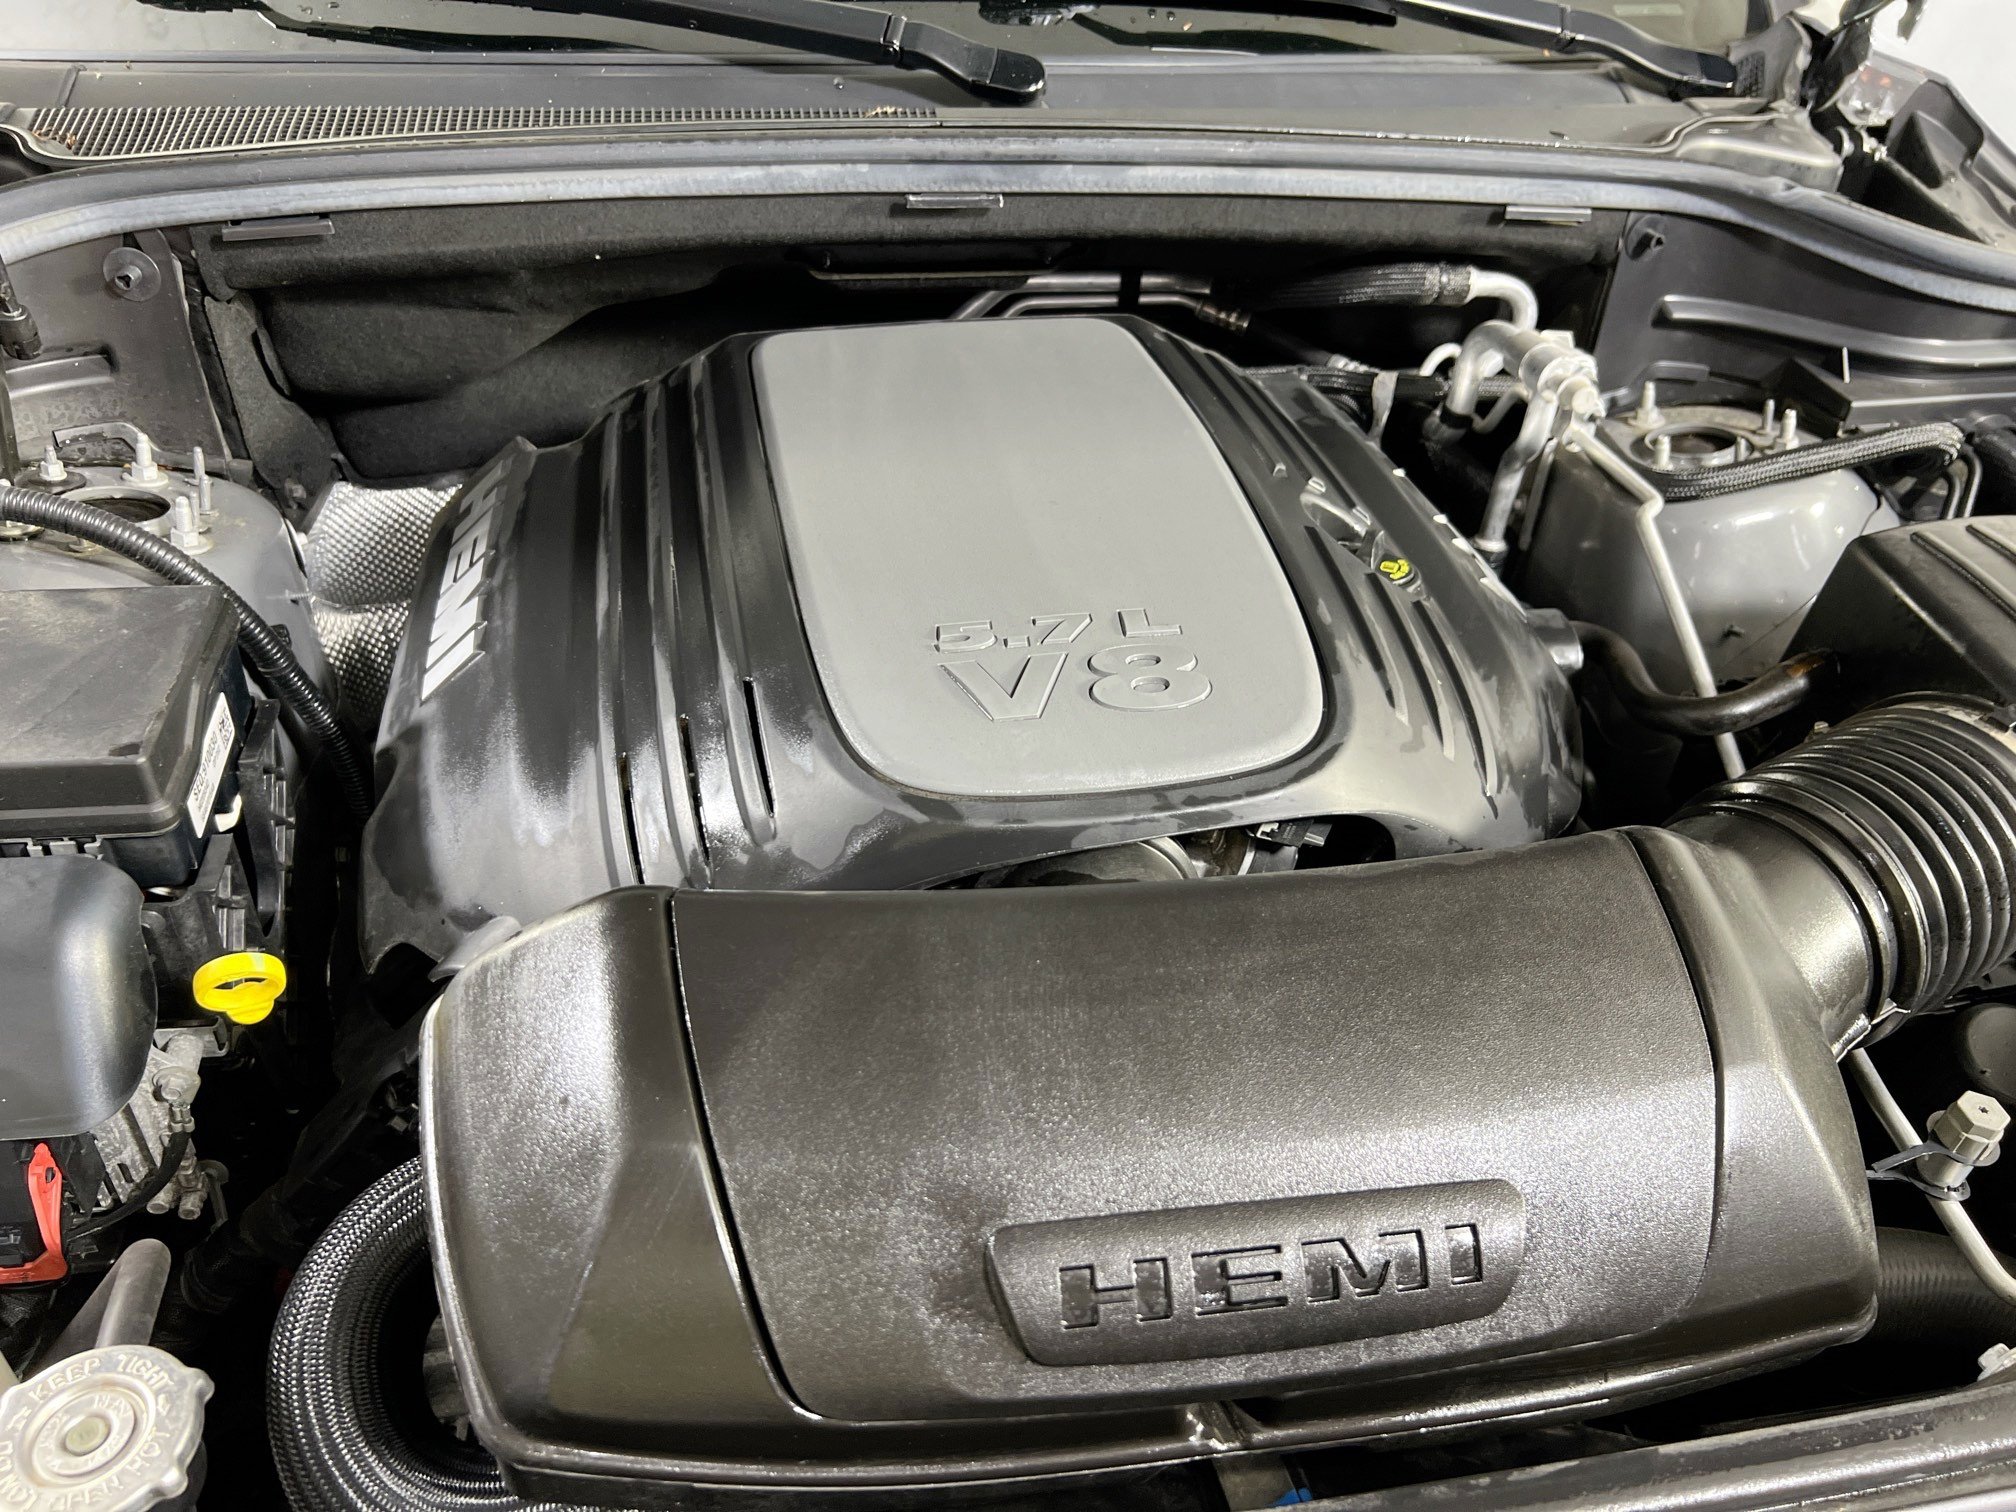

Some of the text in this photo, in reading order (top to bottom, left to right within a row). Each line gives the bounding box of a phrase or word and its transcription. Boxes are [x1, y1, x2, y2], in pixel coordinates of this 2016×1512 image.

[420, 456, 506, 701] HEMI
[936, 642, 1213, 722] V8
[1058, 1222, 1484, 1330] HEMI
[28, 1354, 175, 1403] KEEP TIGHT
